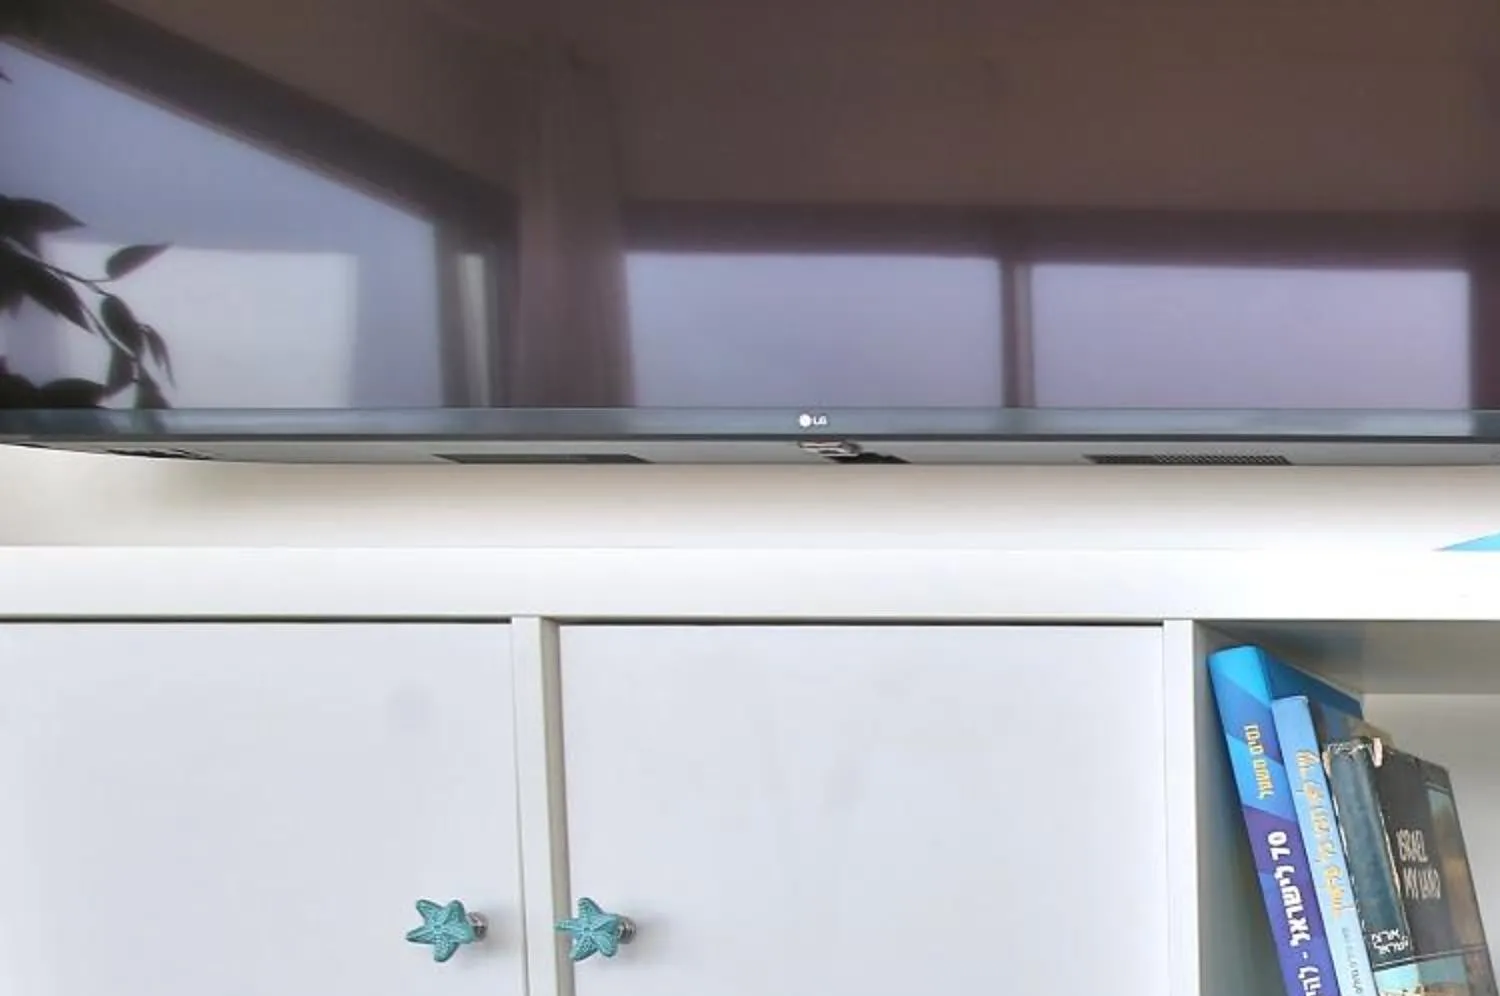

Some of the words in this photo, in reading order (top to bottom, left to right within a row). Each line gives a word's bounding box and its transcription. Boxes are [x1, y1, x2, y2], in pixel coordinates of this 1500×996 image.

[812, 415, 828, 425] LG
[1266, 828, 1290, 861] 70
[1395, 828, 1428, 862] ISRAEL
[1403, 866, 1419, 898] MY
[1418, 866, 1440, 899] LAND
[1273, 862, 1310, 947] לישראל
